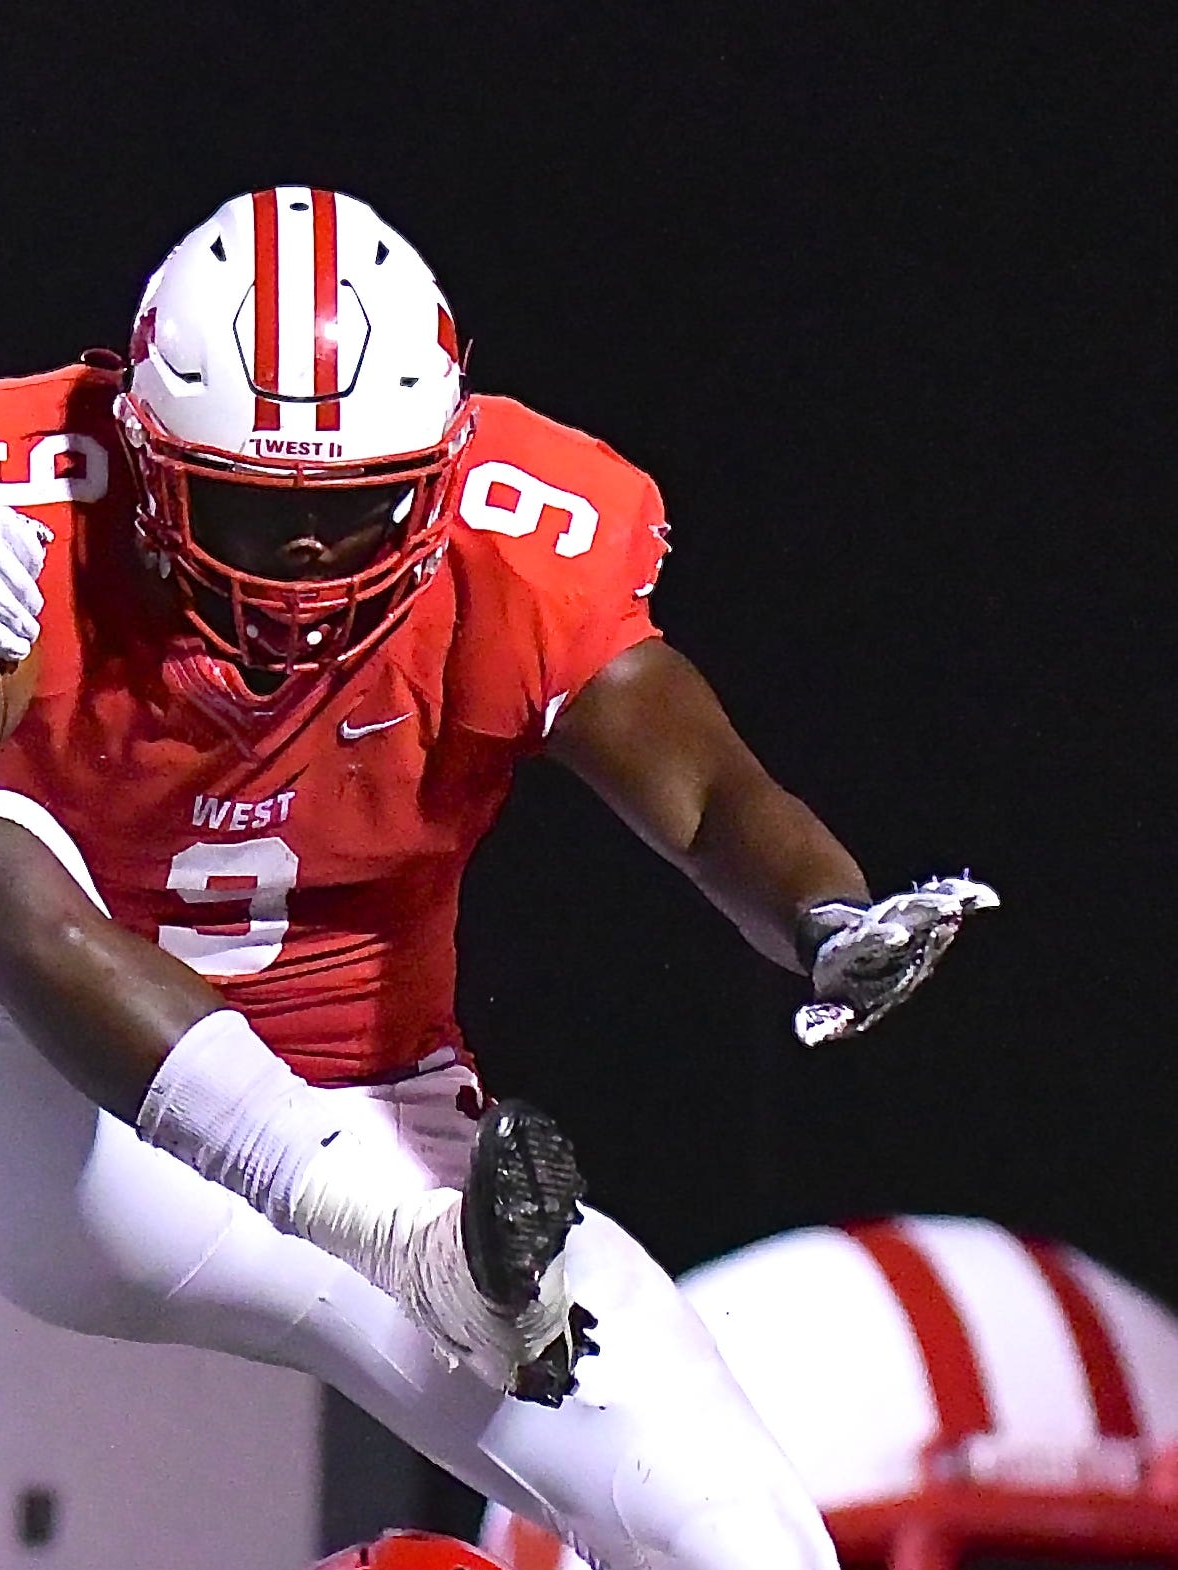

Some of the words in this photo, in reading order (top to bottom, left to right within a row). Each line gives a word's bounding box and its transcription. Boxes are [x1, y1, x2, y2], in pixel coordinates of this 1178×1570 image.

[265, 438, 323, 456] WEST
[459, 460, 599, 559] 9
[192, 791, 296, 831] WEST
